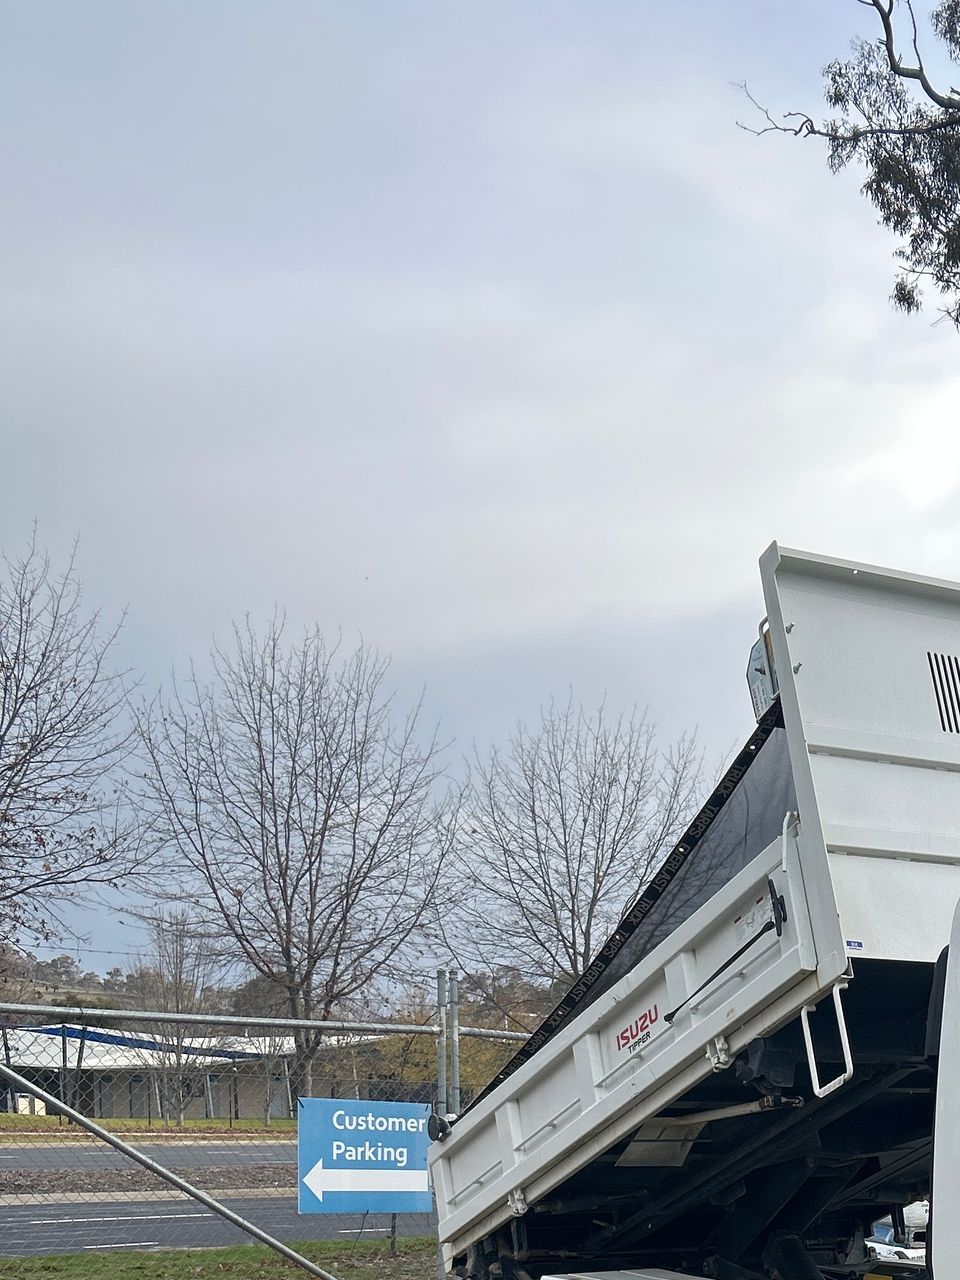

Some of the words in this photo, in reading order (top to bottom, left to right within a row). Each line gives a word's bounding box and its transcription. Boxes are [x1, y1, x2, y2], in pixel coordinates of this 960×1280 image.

[715, 761, 746, 799] TRUCK
[687, 803, 718, 839] TARPS
[627, 895, 651, 926] TRUCK
[568, 960, 605, 1001] EVERLAST
[616, 1004, 658, 1051] ISUZU
[628, 1031, 650, 1053] TIPPER
[333, 1110, 426, 1132] Customer
[333, 1141, 408, 1167] Parking
